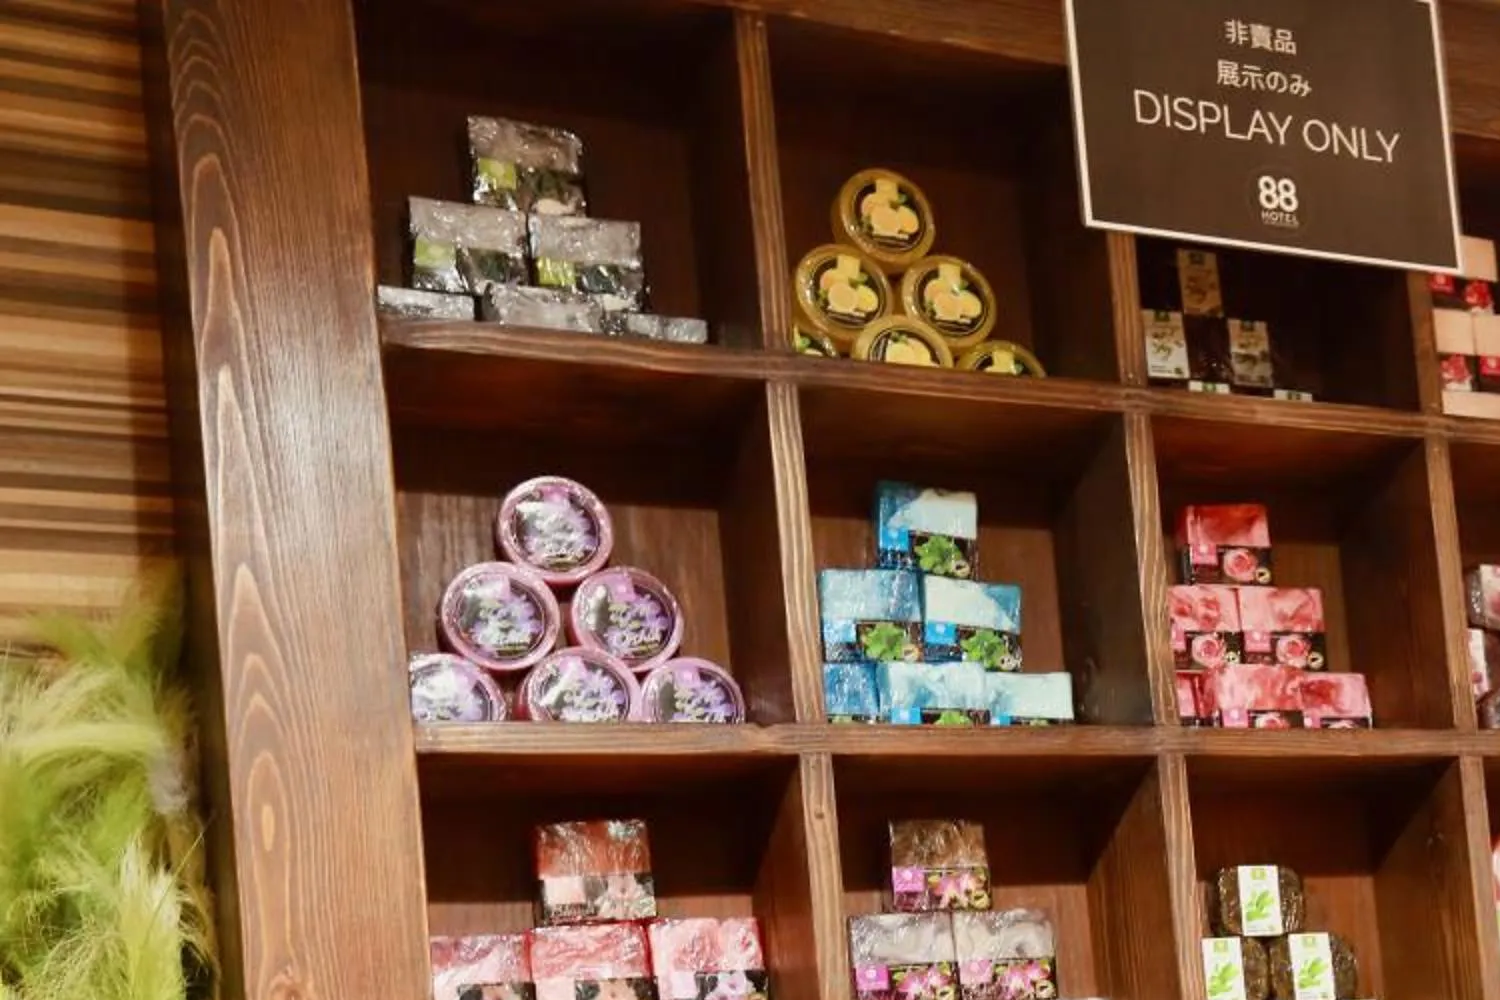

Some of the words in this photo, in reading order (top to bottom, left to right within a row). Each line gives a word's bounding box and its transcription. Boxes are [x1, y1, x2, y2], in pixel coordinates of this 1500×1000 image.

[1217, 59, 1312, 97] 展示のみ
[1133, 89, 1292, 146] DISPLAY
[1303, 119, 1400, 163] ONLY
[1258, 175, 1299, 212] 88
[1261, 209, 1298, 224] HOTEL
